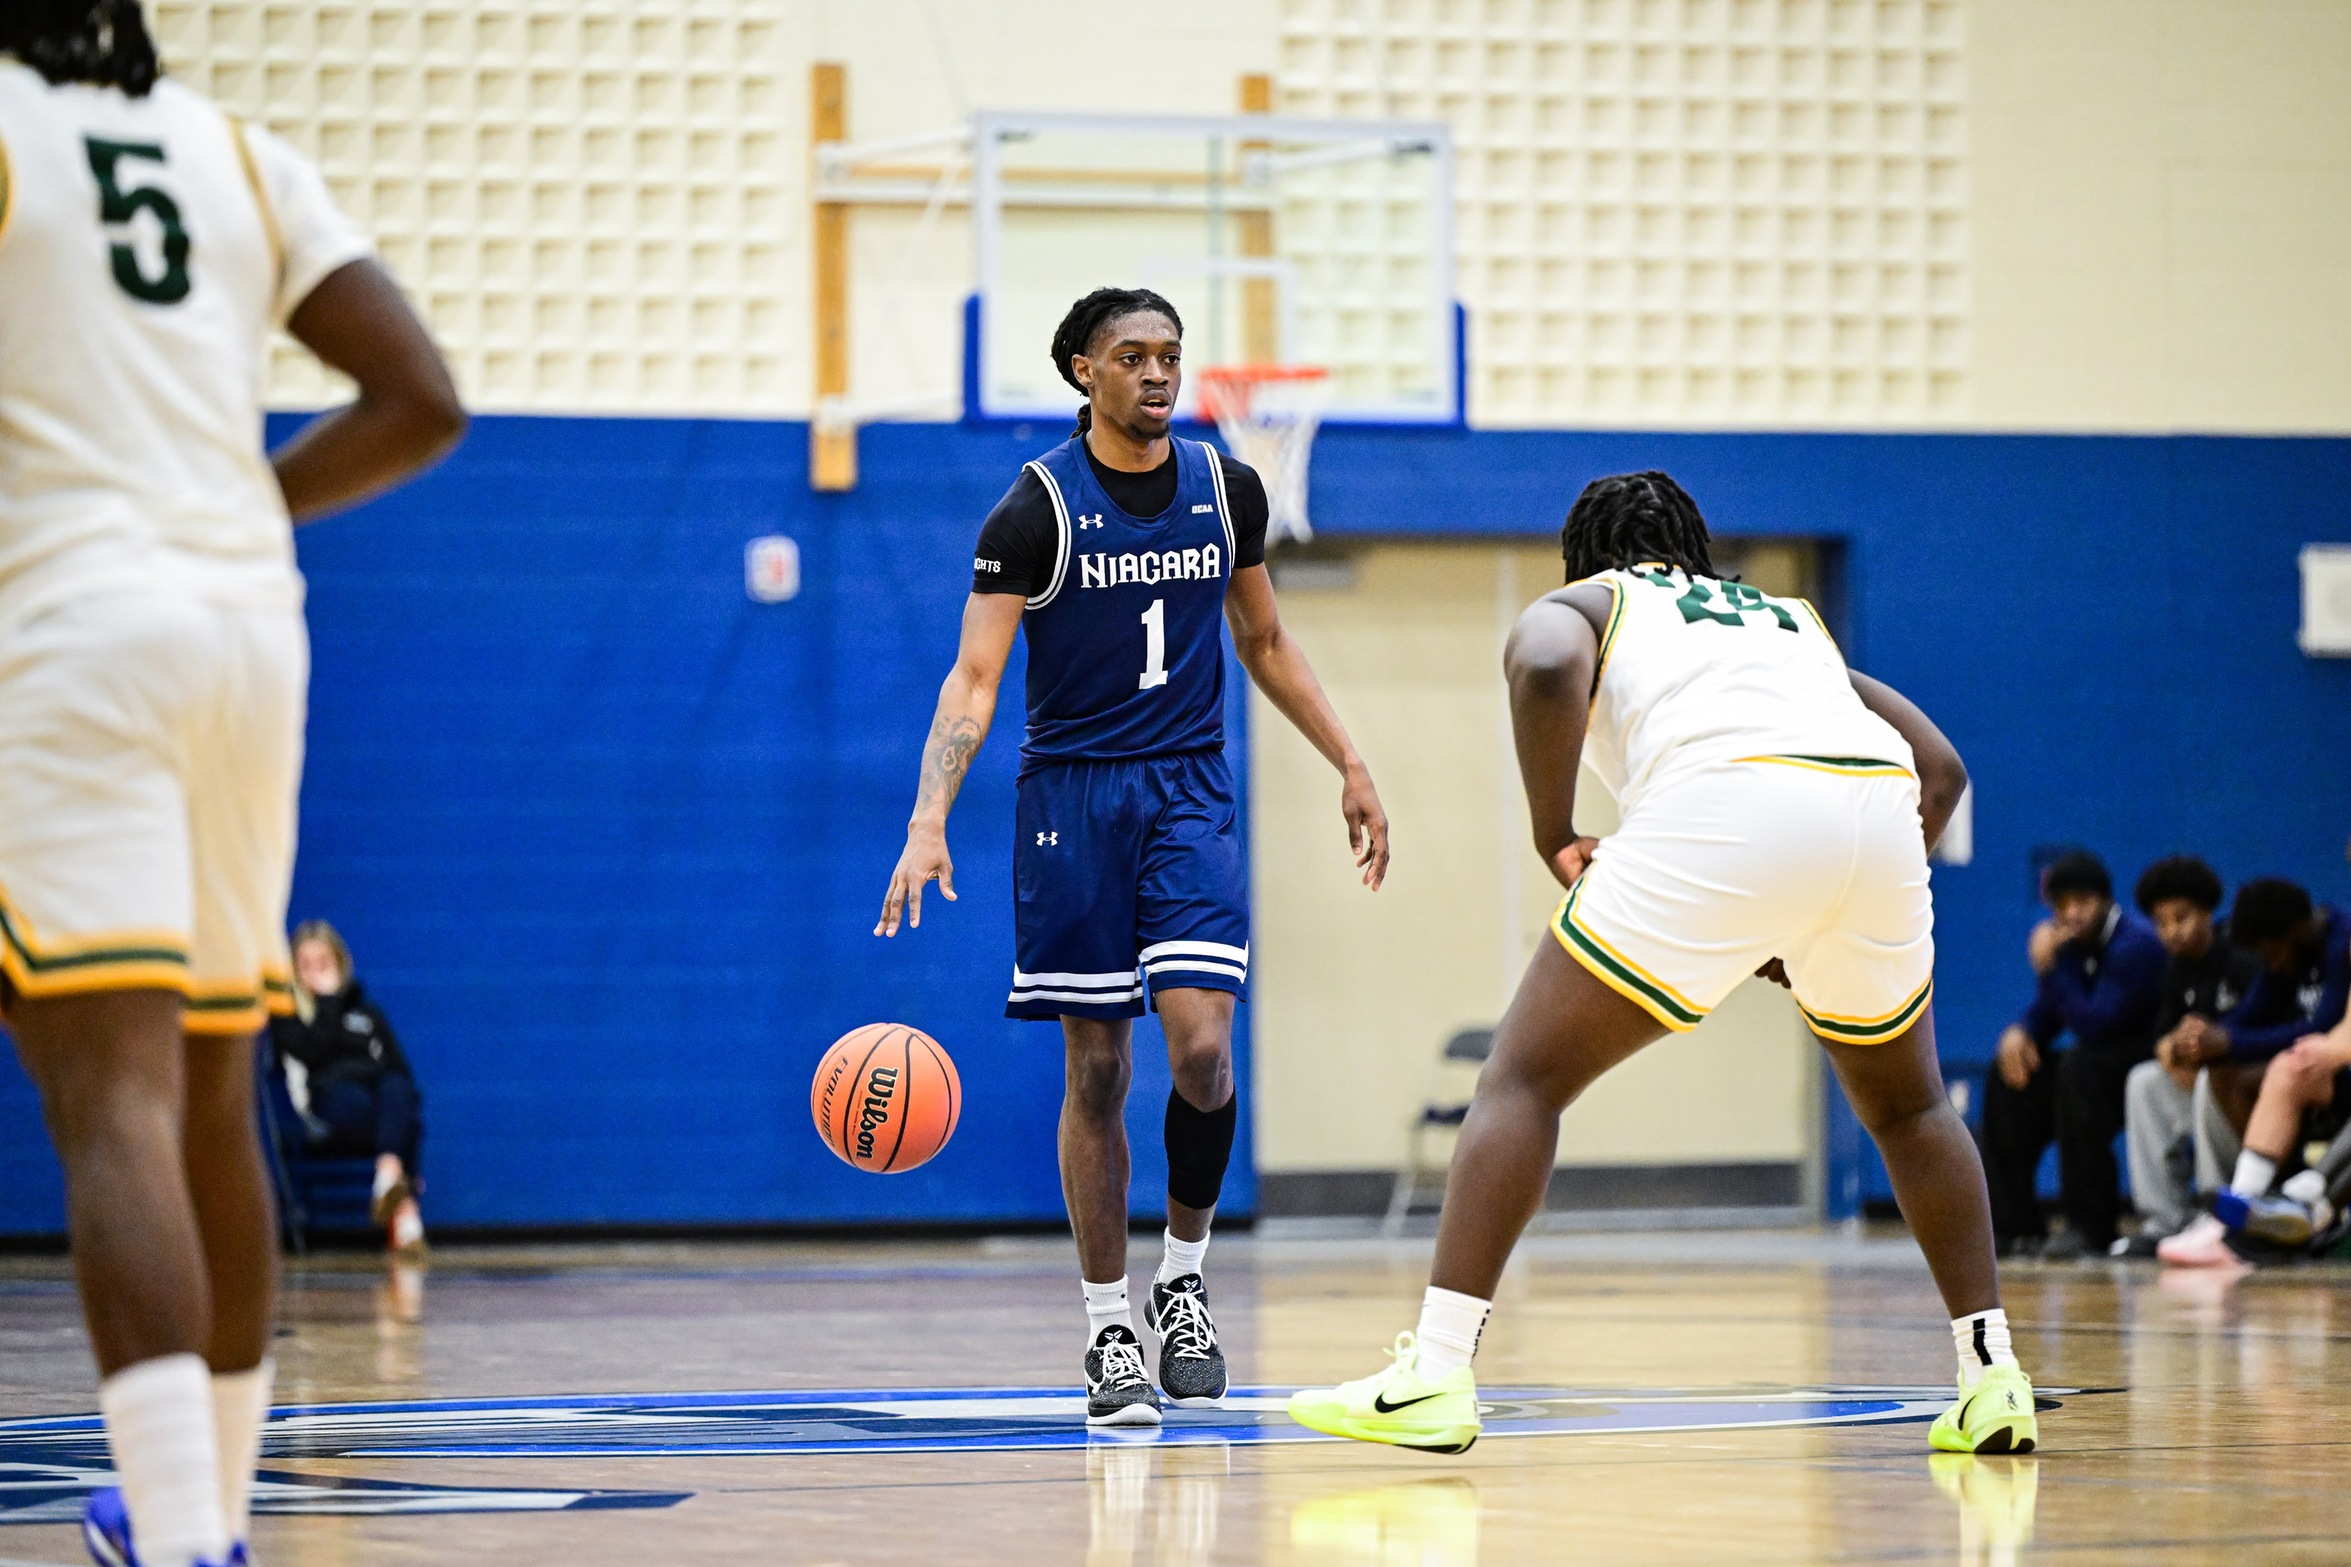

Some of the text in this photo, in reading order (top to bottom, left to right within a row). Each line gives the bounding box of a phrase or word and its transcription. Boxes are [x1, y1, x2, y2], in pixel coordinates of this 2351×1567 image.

[84, 134, 191, 304] 5
[1078, 542, 1221, 588] NIAGARA
[1138, 598, 1169, 690] 1
[856, 1067, 899, 1159] Wilson
